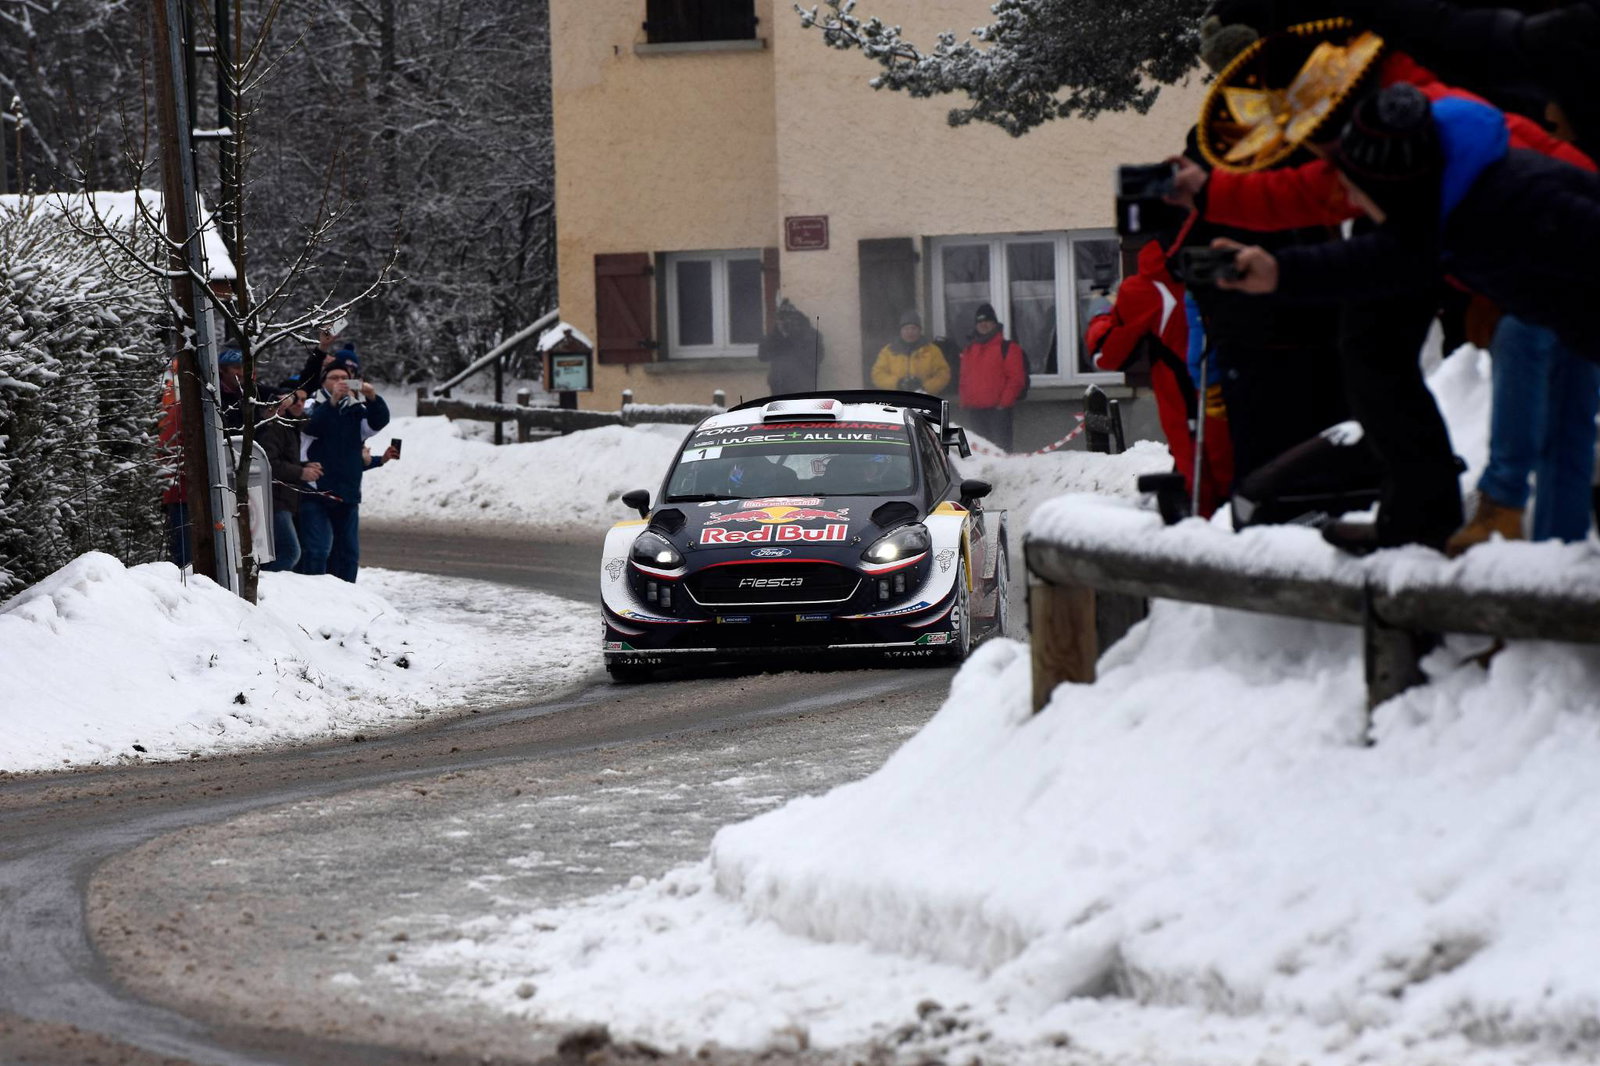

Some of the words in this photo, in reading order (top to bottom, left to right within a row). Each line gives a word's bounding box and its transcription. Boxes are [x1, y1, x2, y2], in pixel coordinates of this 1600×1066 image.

[696, 426, 748, 437] FORD
[749, 422, 901, 431] PERFORMANCE
[698, 448, 708, 460] 1
[700, 525, 773, 544] Red
[776, 524, 848, 541] Bull
[756, 548, 787, 557] Ford
